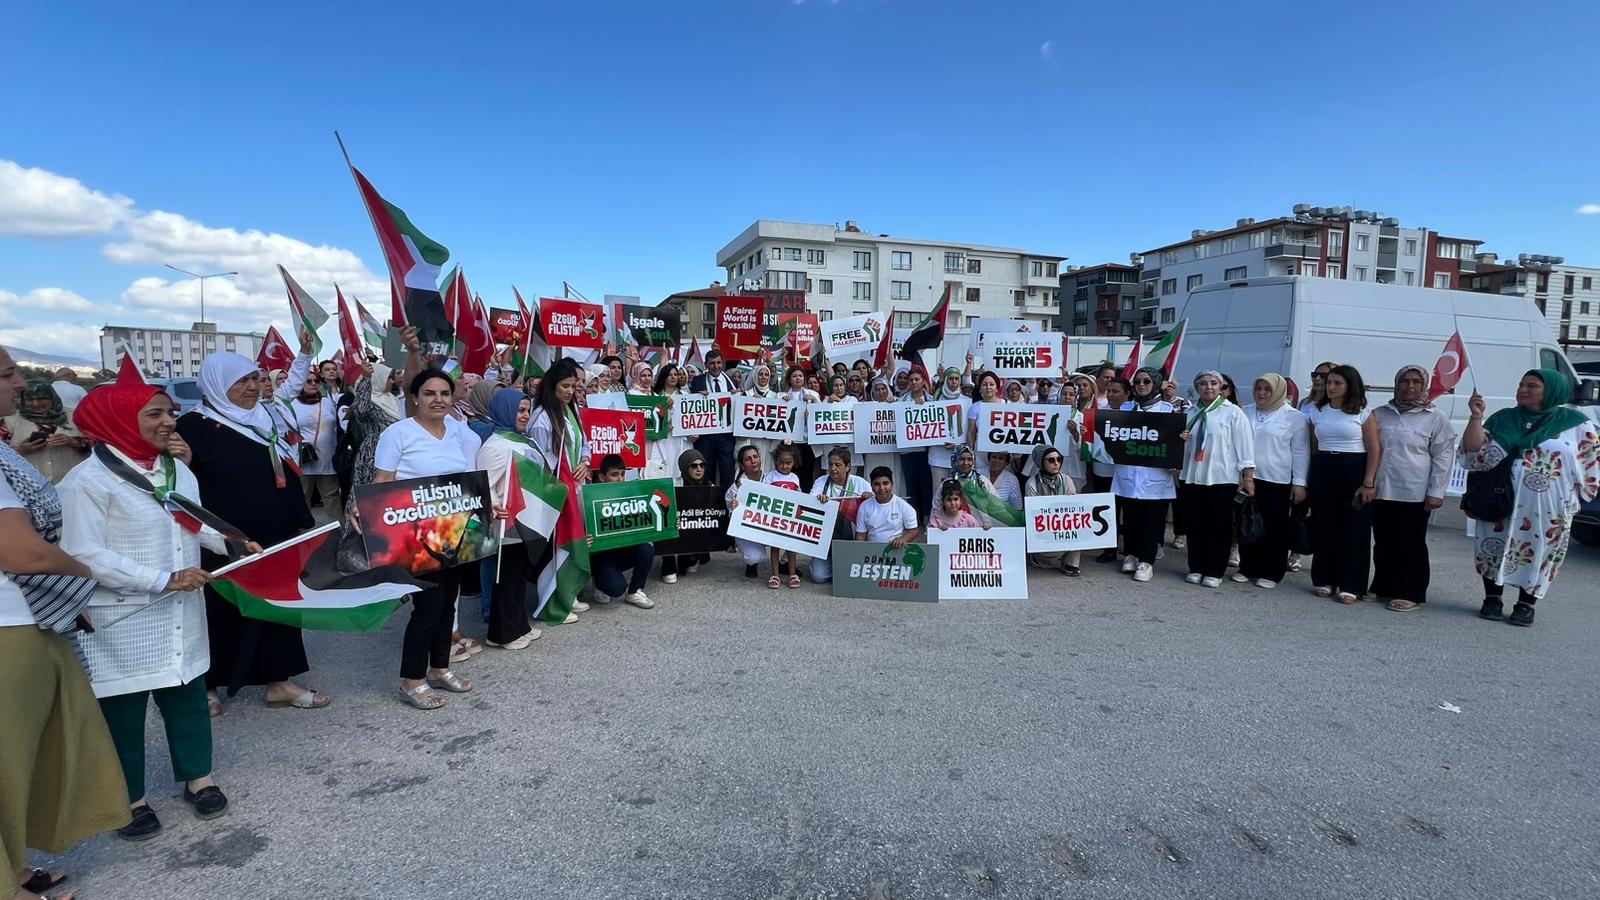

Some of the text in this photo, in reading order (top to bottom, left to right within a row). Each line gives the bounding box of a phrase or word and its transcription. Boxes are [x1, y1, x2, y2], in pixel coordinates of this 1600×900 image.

[763, 293, 804, 309] ZAR
[723, 314, 757, 323] World is
[724, 306, 757, 315] A Fairer
[551, 312, 577, 327] ÖZGÜR
[629, 313, 665, 330] İşgale
[722, 322, 757, 330] Possible
[548, 323, 582, 337] FİLİSTİN
[645, 328, 671, 342] Son!
[831, 329, 862, 342] FREE
[833, 337, 868, 348] PALESTINE
[993, 356, 1035, 369] THAN
[995, 347, 1052, 369] BIGGER 5
[680, 398, 717, 414] ÖZGÜR
[743, 402, 788, 419] FREE
[681, 413, 717, 430] GAZZE
[814, 410, 848, 421] FREE
[876, 410, 896, 421] BARI
[904, 407, 945, 424] ÖZGÜR
[989, 410, 1046, 429] FREE
[591, 425, 618, 441] ÖZGÜR
[742, 417, 787, 433] GAZA
[814, 422, 854, 432] PALEST
[906, 422, 946, 441] GAZZE
[1104, 420, 1159, 441] İşgale
[870, 433, 897, 445] MÜMK
[988, 428, 1046, 445] GAZA
[588, 440, 621, 454] FİLİSTİN
[1125, 440, 1167, 457] Son!
[411, 481, 462, 504] FİLİSTİN
[383, 496, 484, 526] ÖZGÜR OLACAK
[602, 498, 648, 518] ÖZGÜR
[681, 509, 694, 517] Adil
[695, 508, 704, 516] Bir
[705, 508, 726, 517] Dünya
[745, 492, 794, 518] FREE
[1055, 506, 1076, 514] WORLD
[601, 512, 653, 532] FİLİSTİN
[676, 516, 719, 530] ümkün
[742, 509, 822, 540] PALESTINE
[1034, 505, 1111, 537] BIGGER 5
[1053, 531, 1078, 541] THAN
[958, 537, 995, 555] BARIŞ
[864, 554, 897, 565] DÜNYA
[951, 554, 1001, 570] KADINLA
[849, 563, 912, 581] BEŞTEN
[950, 570, 1002, 588] MÜMKÜN
